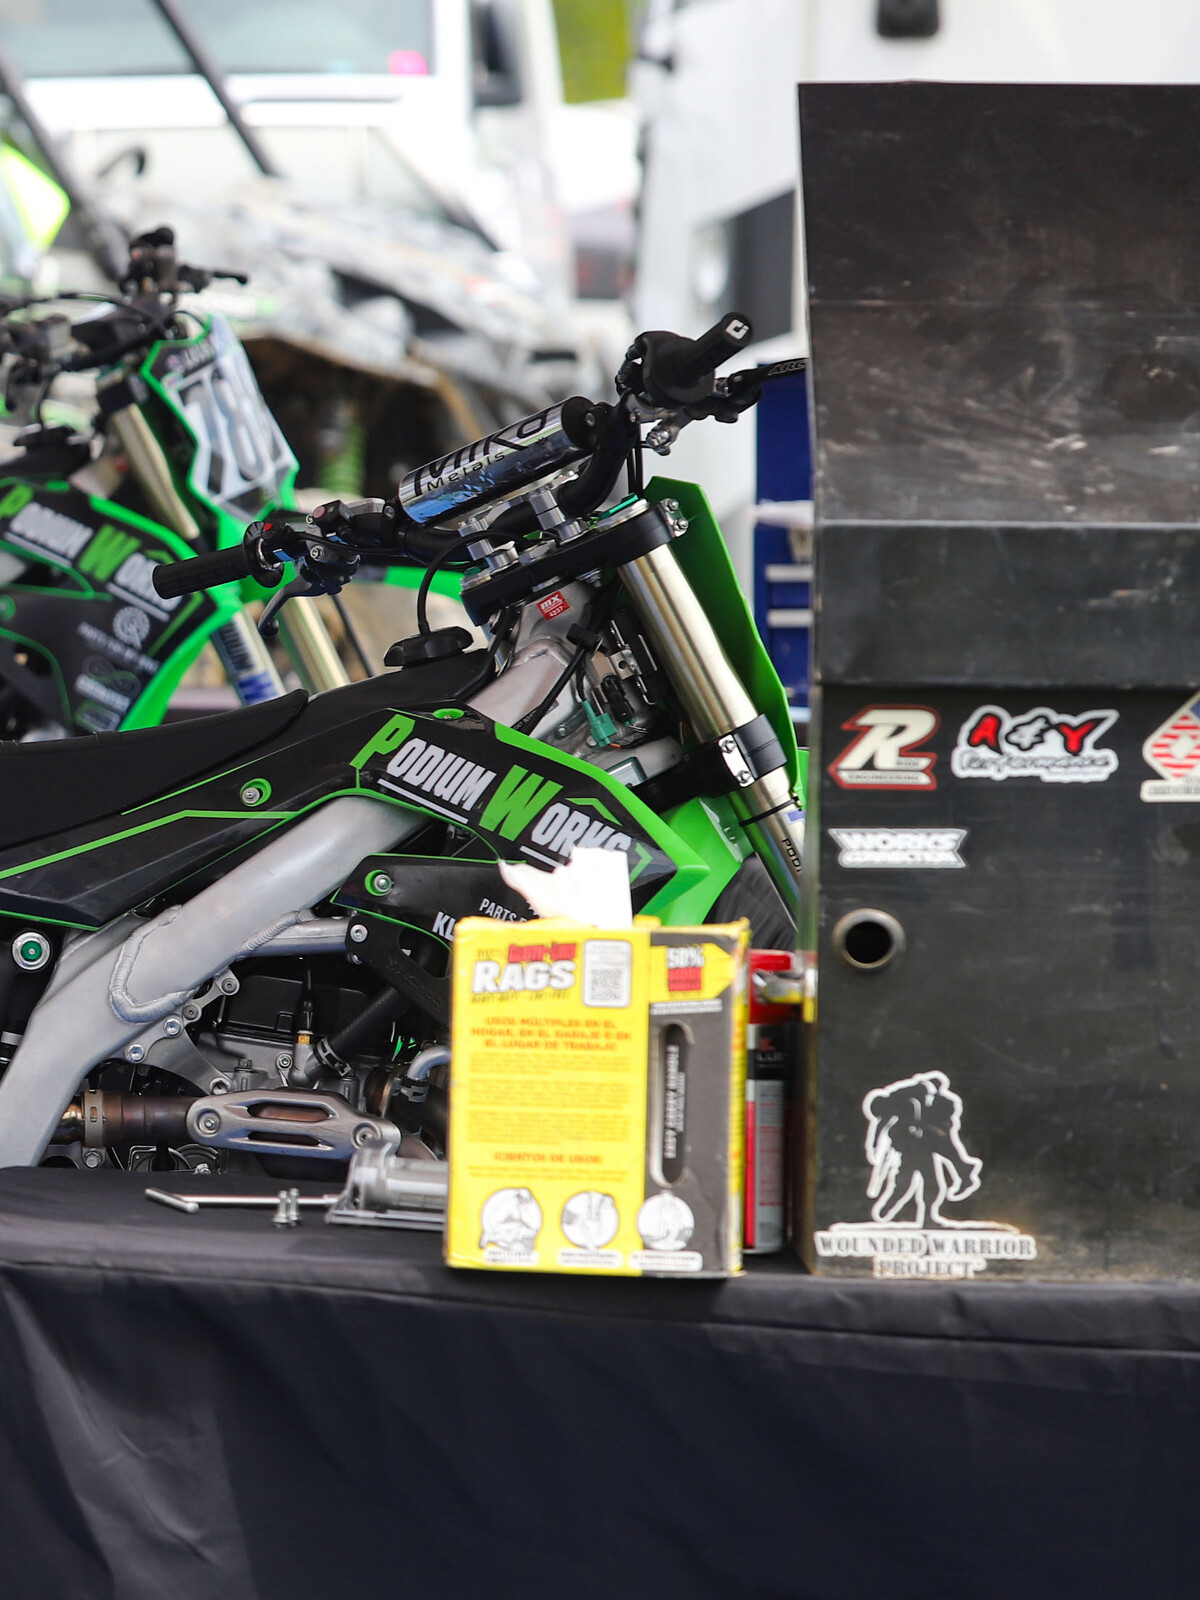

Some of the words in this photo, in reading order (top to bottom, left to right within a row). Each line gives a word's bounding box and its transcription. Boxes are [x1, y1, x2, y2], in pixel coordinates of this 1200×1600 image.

[426, 452, 506, 492] Metals
[349, 714, 497, 812] PODIUM
[479, 898, 517, 922] PARTS
[472, 960, 576, 993] RAGS
[821, 1235, 922, 1254] WOUNDED
[934, 1236, 1031, 1255] WARRIOR
[880, 1259, 974, 1275] PROJECT
